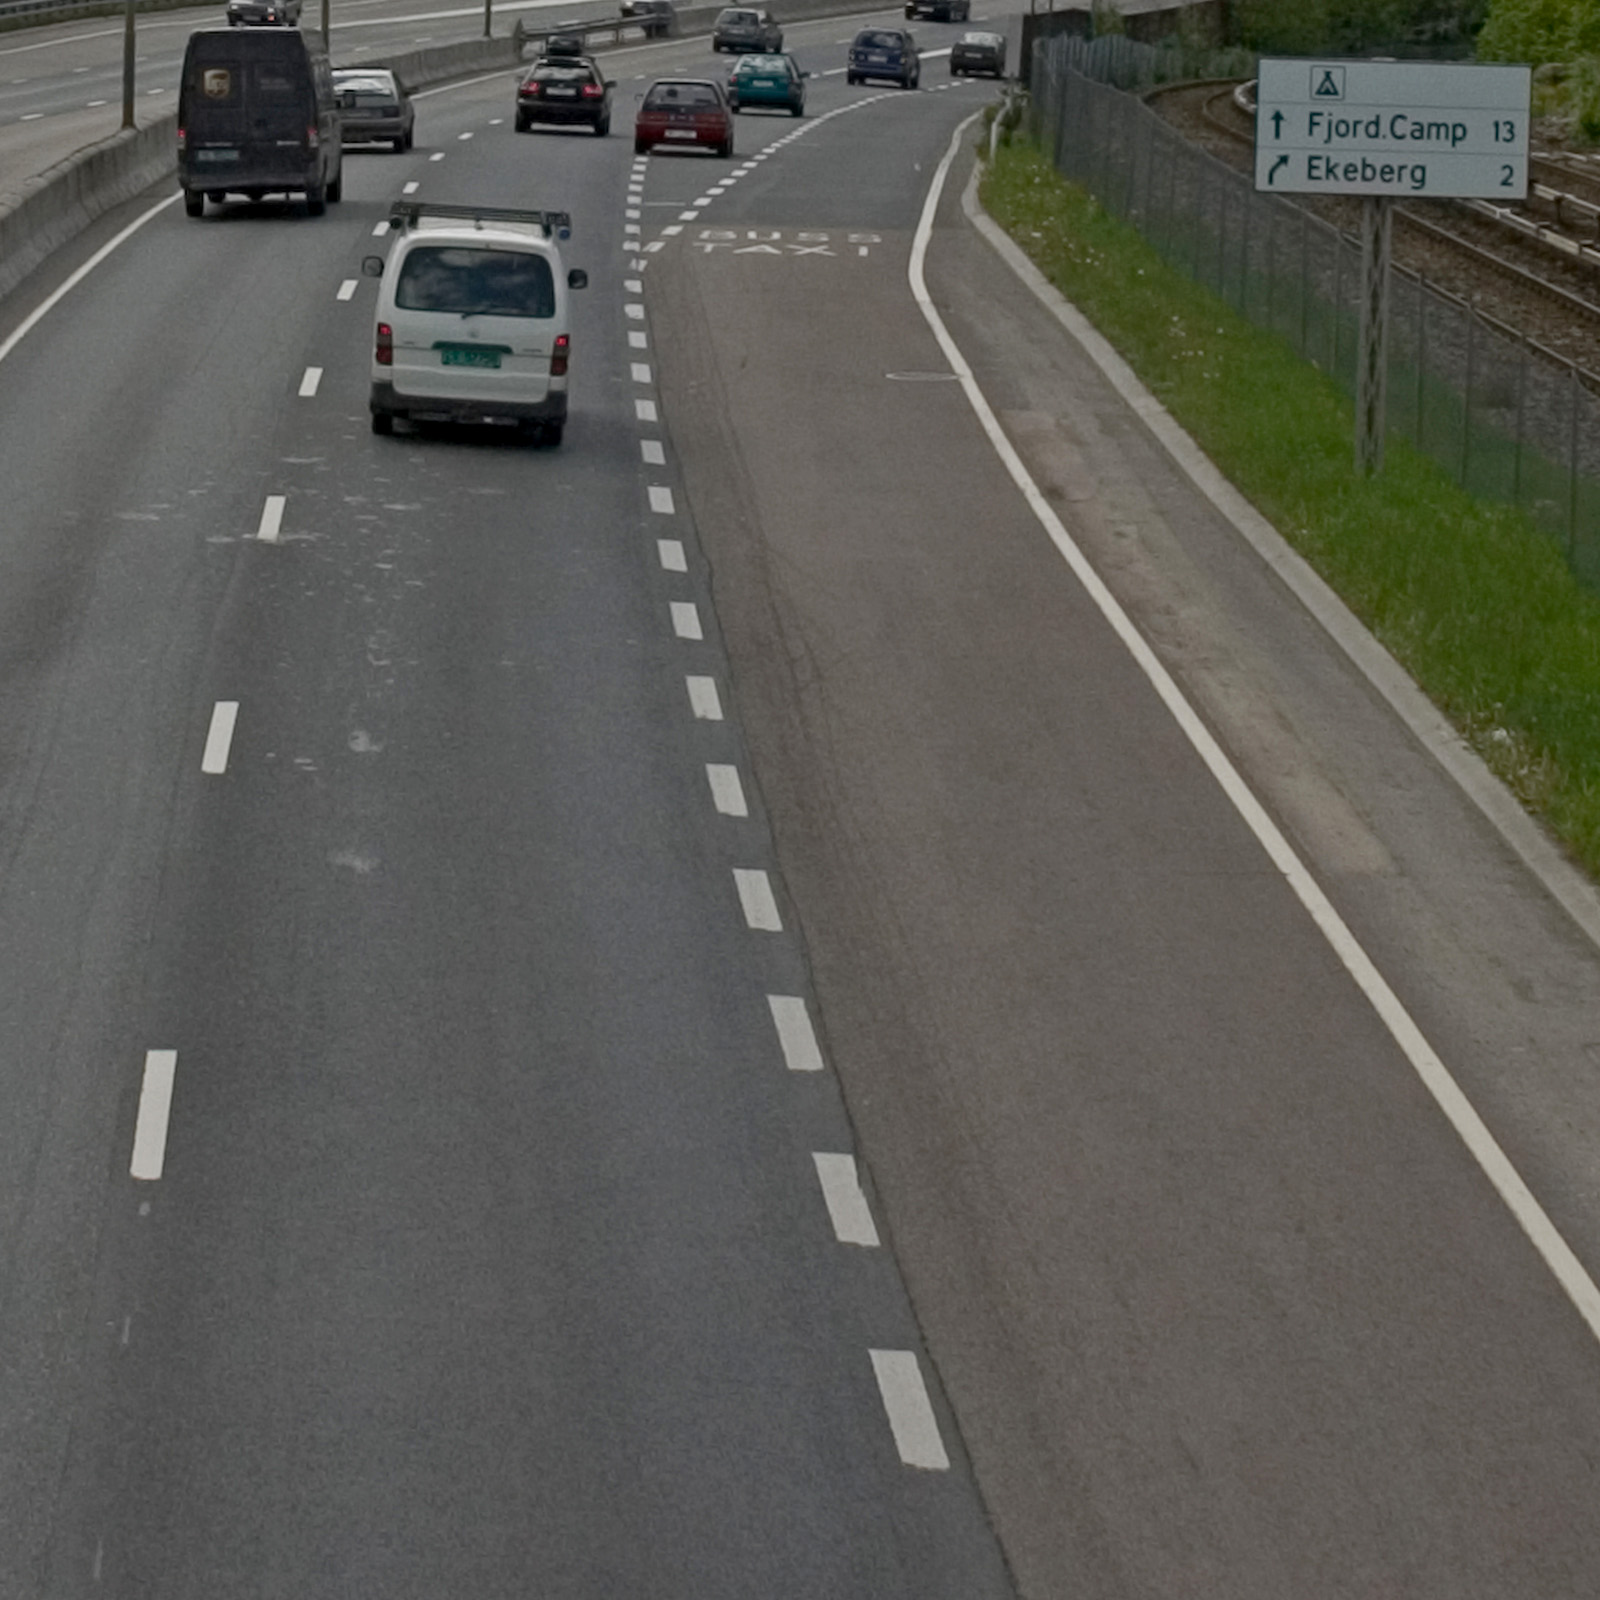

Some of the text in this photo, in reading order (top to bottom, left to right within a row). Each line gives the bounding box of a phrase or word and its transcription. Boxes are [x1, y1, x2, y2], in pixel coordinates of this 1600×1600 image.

[1307, 111, 1516, 148] Fjord.Camp 13
[1307, 154, 1514, 190] Ekeberg 2
[693, 242, 869, 256] TAXI
[699, 231, 881, 243] BUSS
